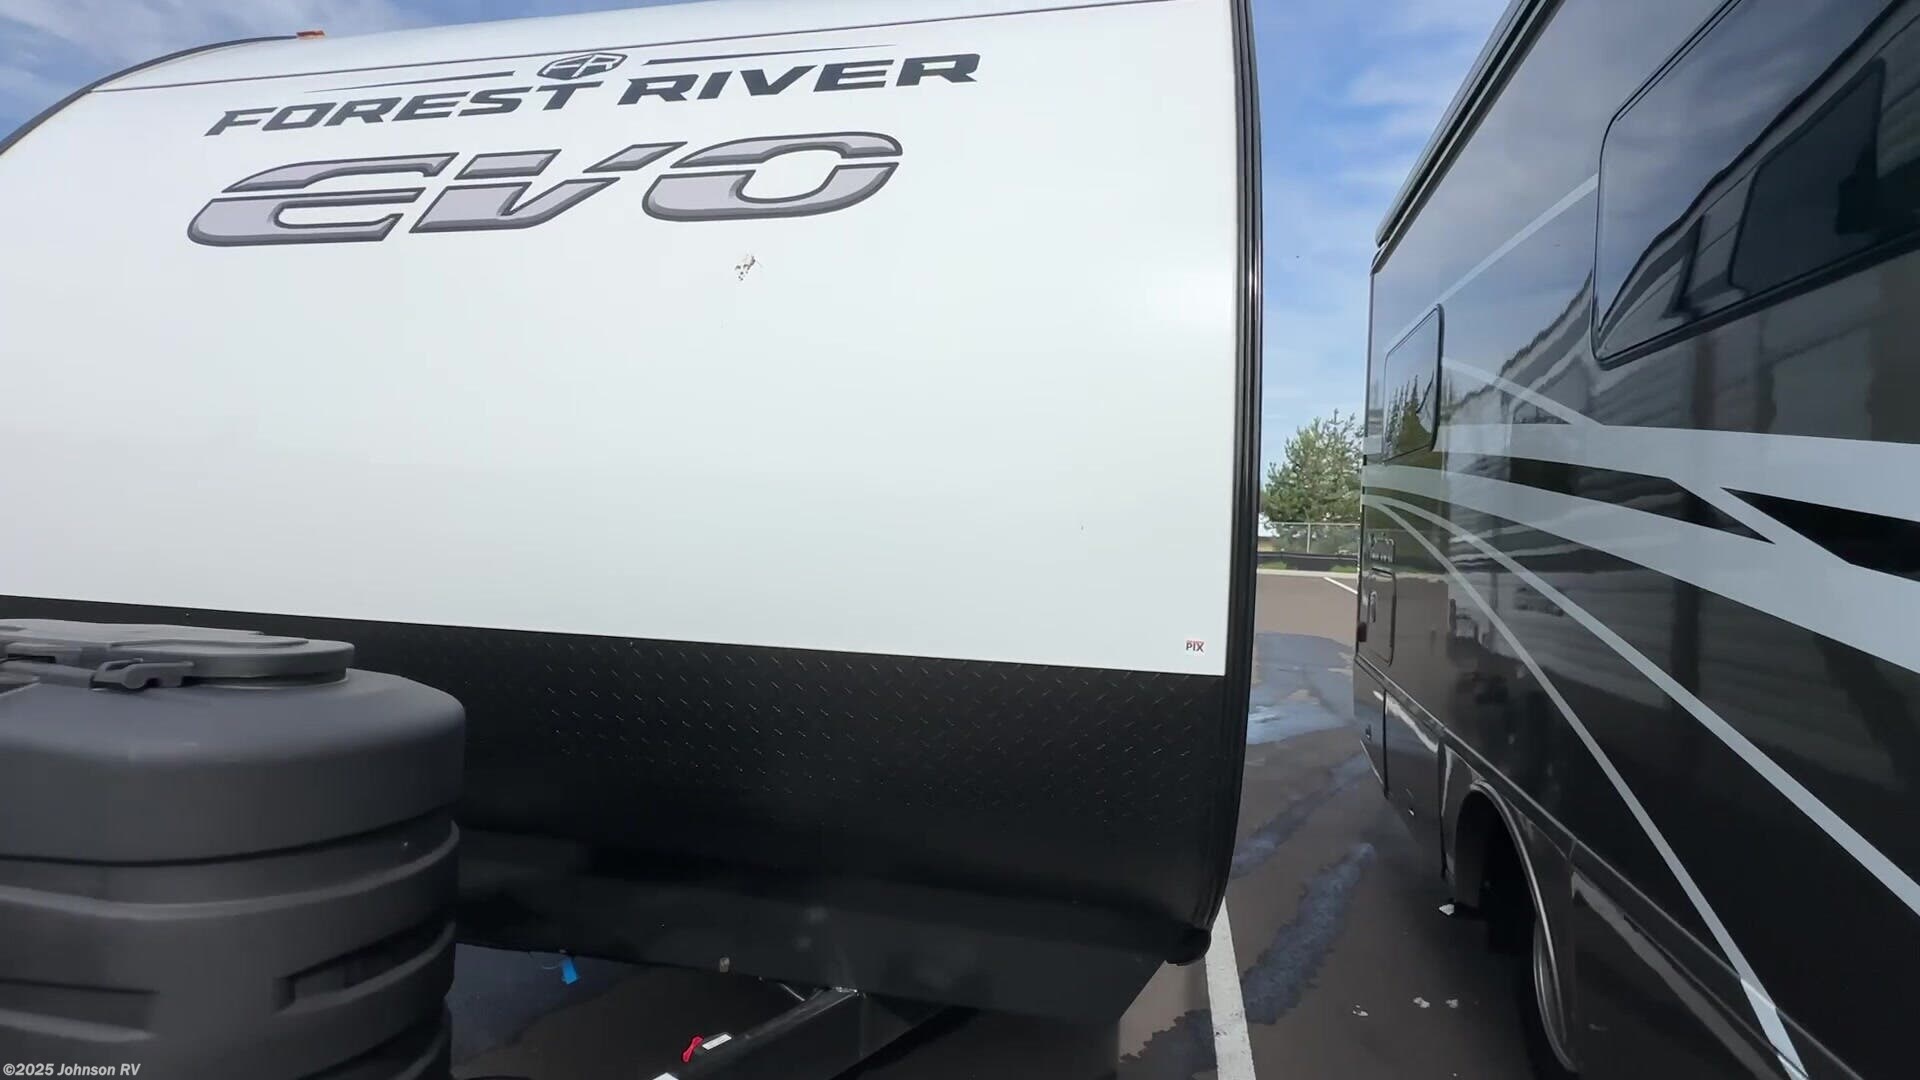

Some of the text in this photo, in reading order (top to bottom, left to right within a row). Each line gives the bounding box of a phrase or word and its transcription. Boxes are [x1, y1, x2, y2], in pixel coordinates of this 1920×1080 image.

[204, 53, 982, 137] FOREST RIVER
[187, 131, 903, 247] EVO
[1185, 640, 1205, 653] PIX
